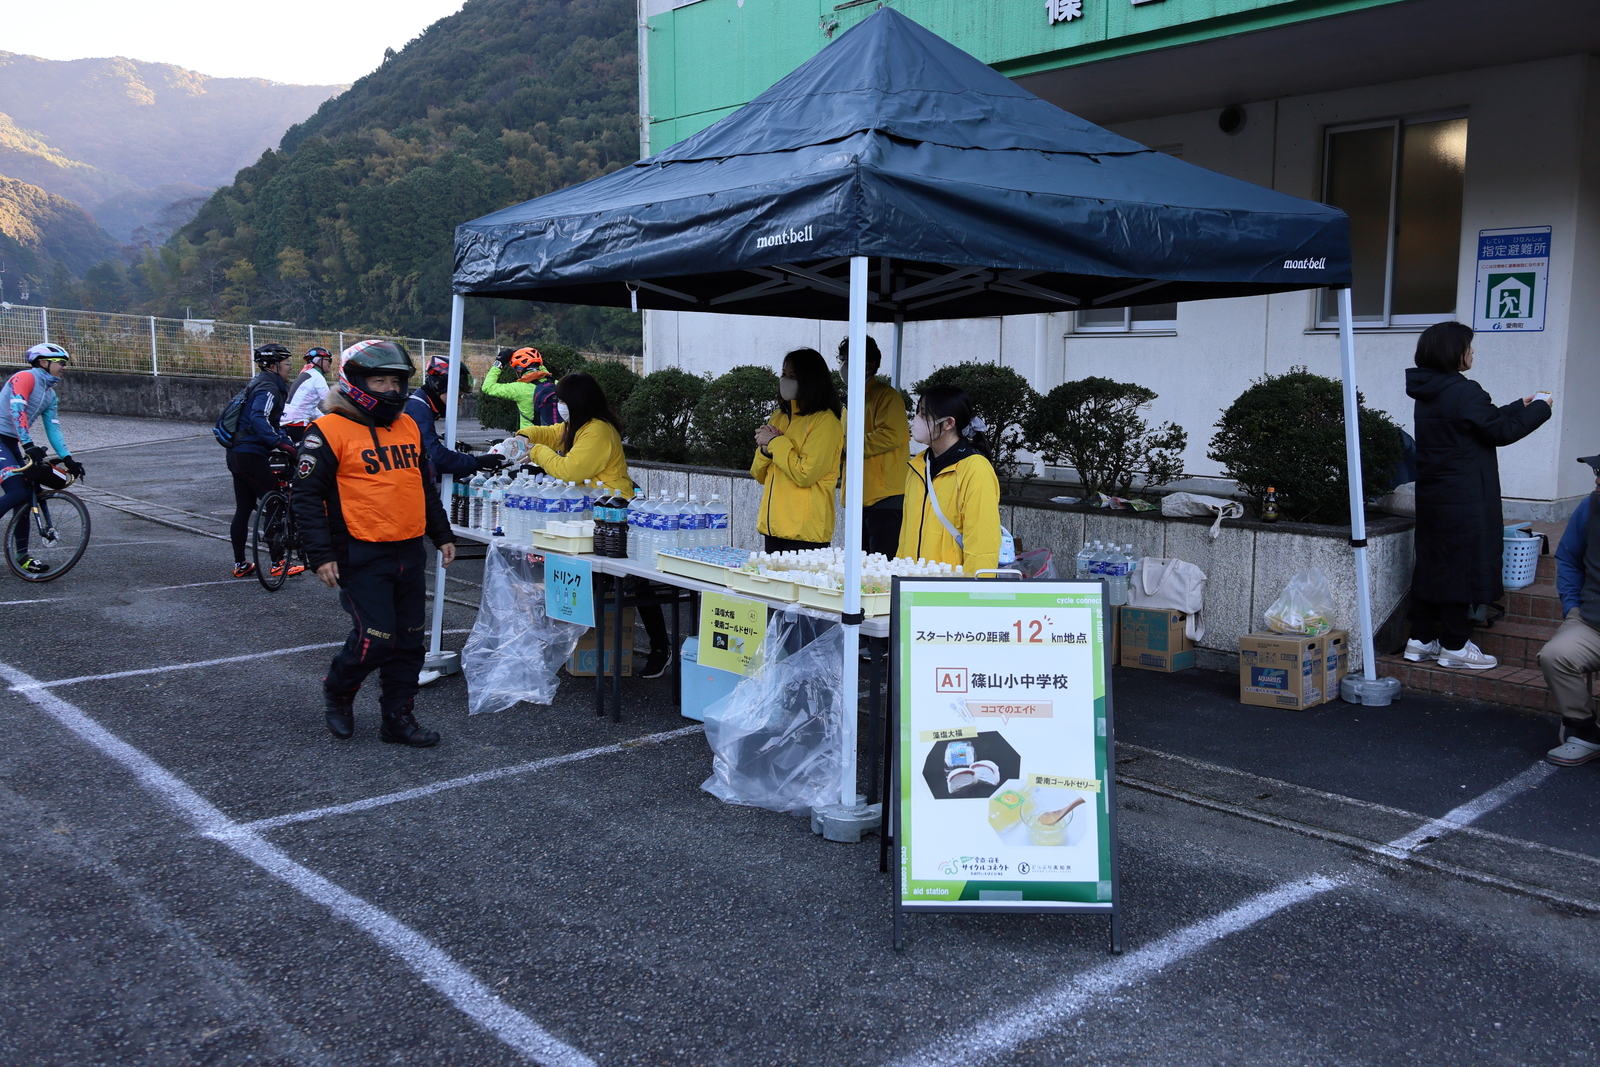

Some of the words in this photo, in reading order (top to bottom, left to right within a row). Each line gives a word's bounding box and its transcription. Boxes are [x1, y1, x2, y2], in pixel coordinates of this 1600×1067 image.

[1482, 242, 1547, 258] 指定避難所
[361, 443, 420, 475] STAFF
[553, 569, 582, 588] ドリンク
[1056, 597, 1075, 605] cycle
[916, 630, 1010, 643] スタートからの距離
[1012, 620, 1043, 643] 12
[941, 673, 962, 688] A1
[971, 672, 1068, 690] 篠山小中学校
[1257, 675, 1282, 684] AQUARIUS
[980, 705, 1037, 714] ココでのエイド
[933, 729, 963, 740] 藻塩大福
[1035, 776, 1096, 788] 愛南ゴールドゼリー
[901, 846, 909, 865] cycle
[913, 887, 924, 896] aid
[926, 887, 950, 896] station
